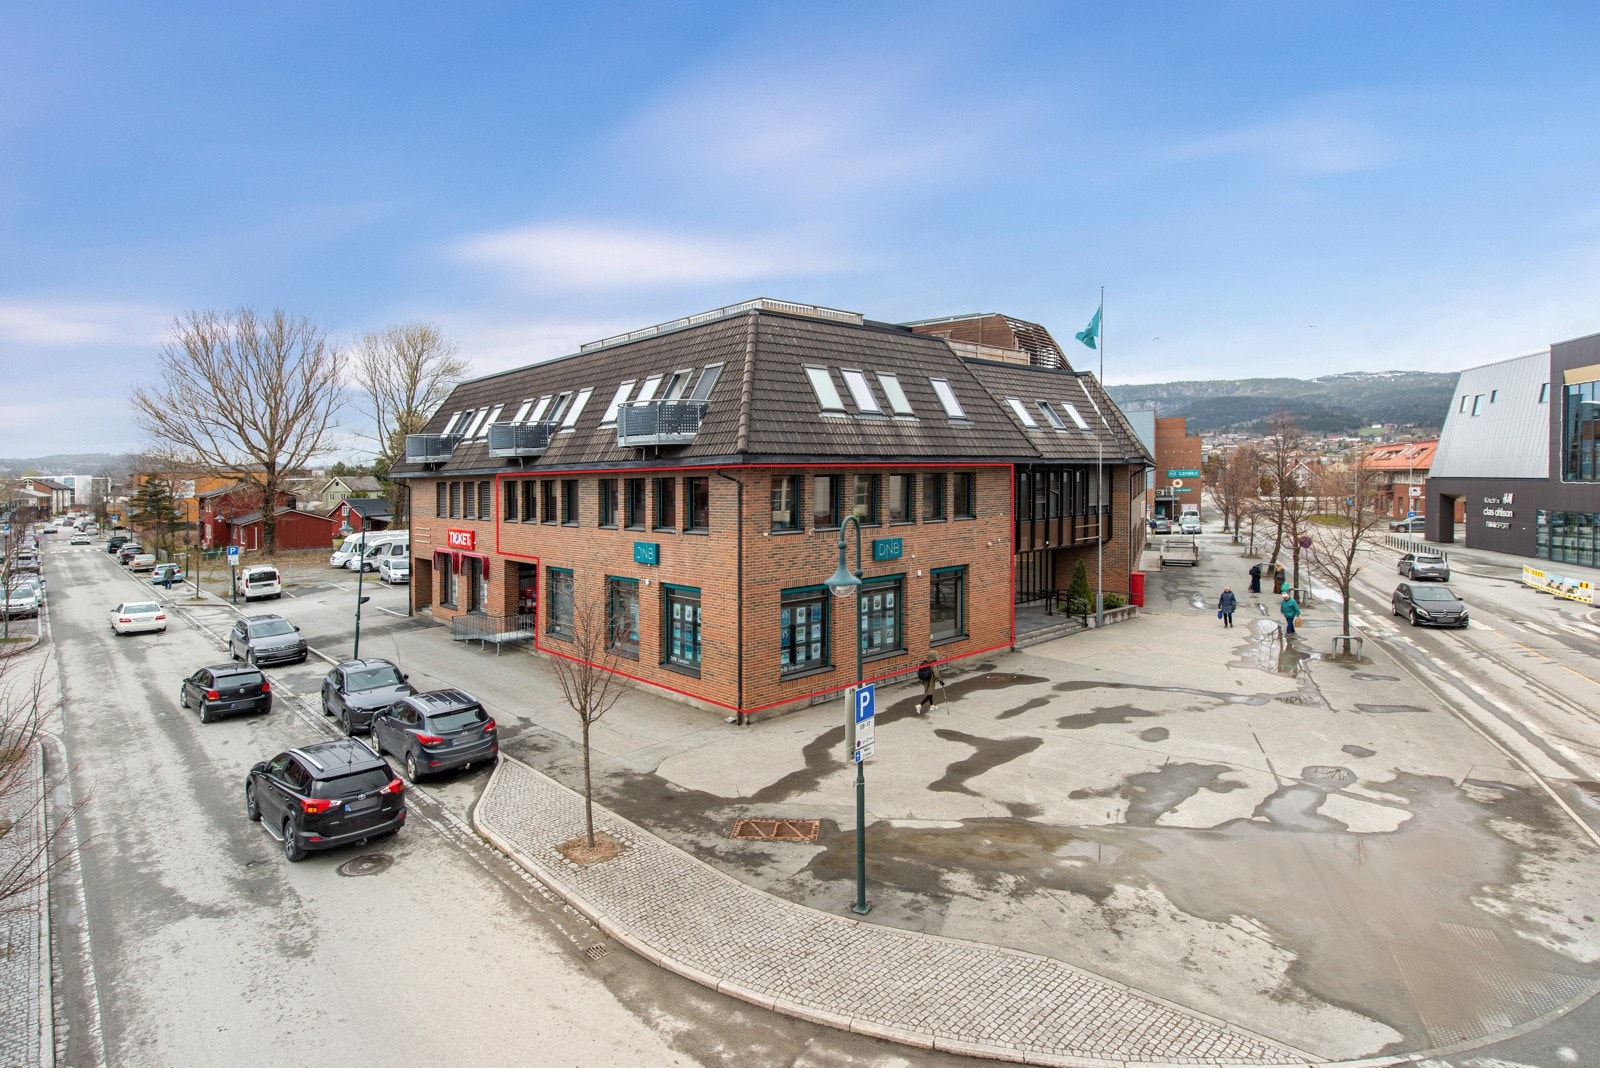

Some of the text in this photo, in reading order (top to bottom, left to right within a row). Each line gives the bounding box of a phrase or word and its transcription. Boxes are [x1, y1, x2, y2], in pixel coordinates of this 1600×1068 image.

[448, 531, 471, 546] TICKET
[229, 547, 237, 555] P
[636, 546, 654, 560] DNB
[879, 542, 900, 556] DNB
[860, 691, 871, 718] P
